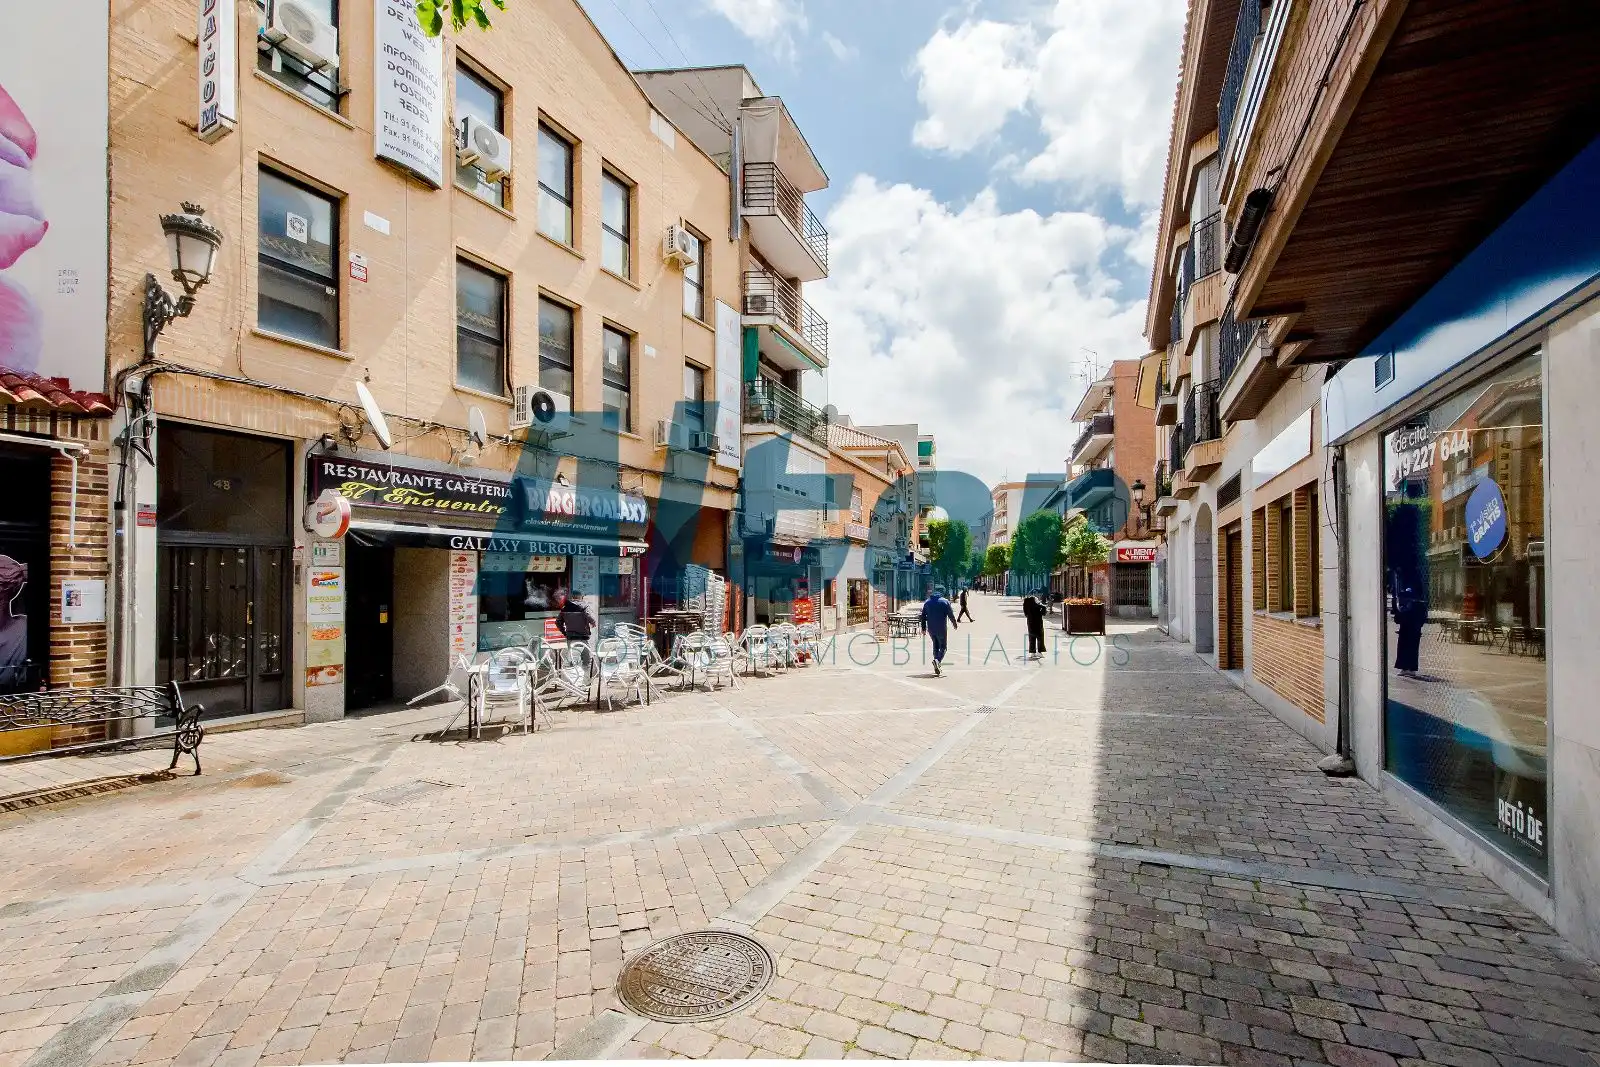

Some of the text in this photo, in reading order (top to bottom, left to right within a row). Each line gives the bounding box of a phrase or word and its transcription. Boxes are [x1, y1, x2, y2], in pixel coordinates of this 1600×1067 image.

[387, 6, 403, 21] DE
[399, 98, 430, 124] REDES
[1412, 441, 1436, 473] 227
[1440, 428, 1470, 461] 644
[323, 462, 513, 499] RESTAURANTE CAFETERIA
[383, 487, 508, 514] Encuentro
[1473, 506, 1501, 543] GRATIS
[450, 536, 595, 556] GALAXY BURGUER
[1498, 798, 1525, 834] RETO
[1527, 812, 1543, 846] DE
